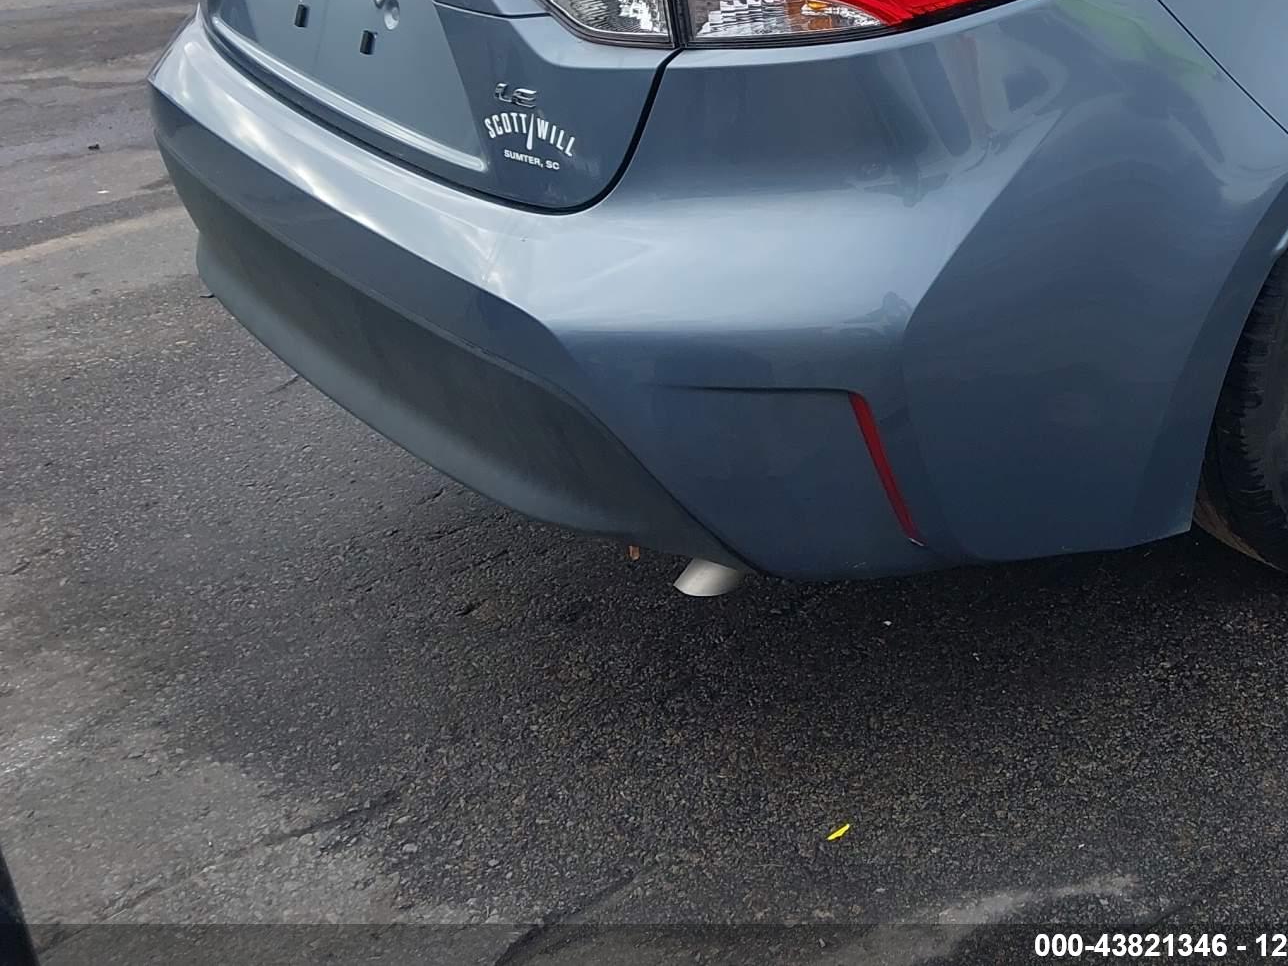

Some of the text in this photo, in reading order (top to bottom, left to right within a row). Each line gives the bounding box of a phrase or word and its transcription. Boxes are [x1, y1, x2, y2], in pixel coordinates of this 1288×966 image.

[494, 82, 537, 108] LE
[484, 112, 576, 157] SCOTT WILL
[503, 149, 560, 171] SUMTER, SC
